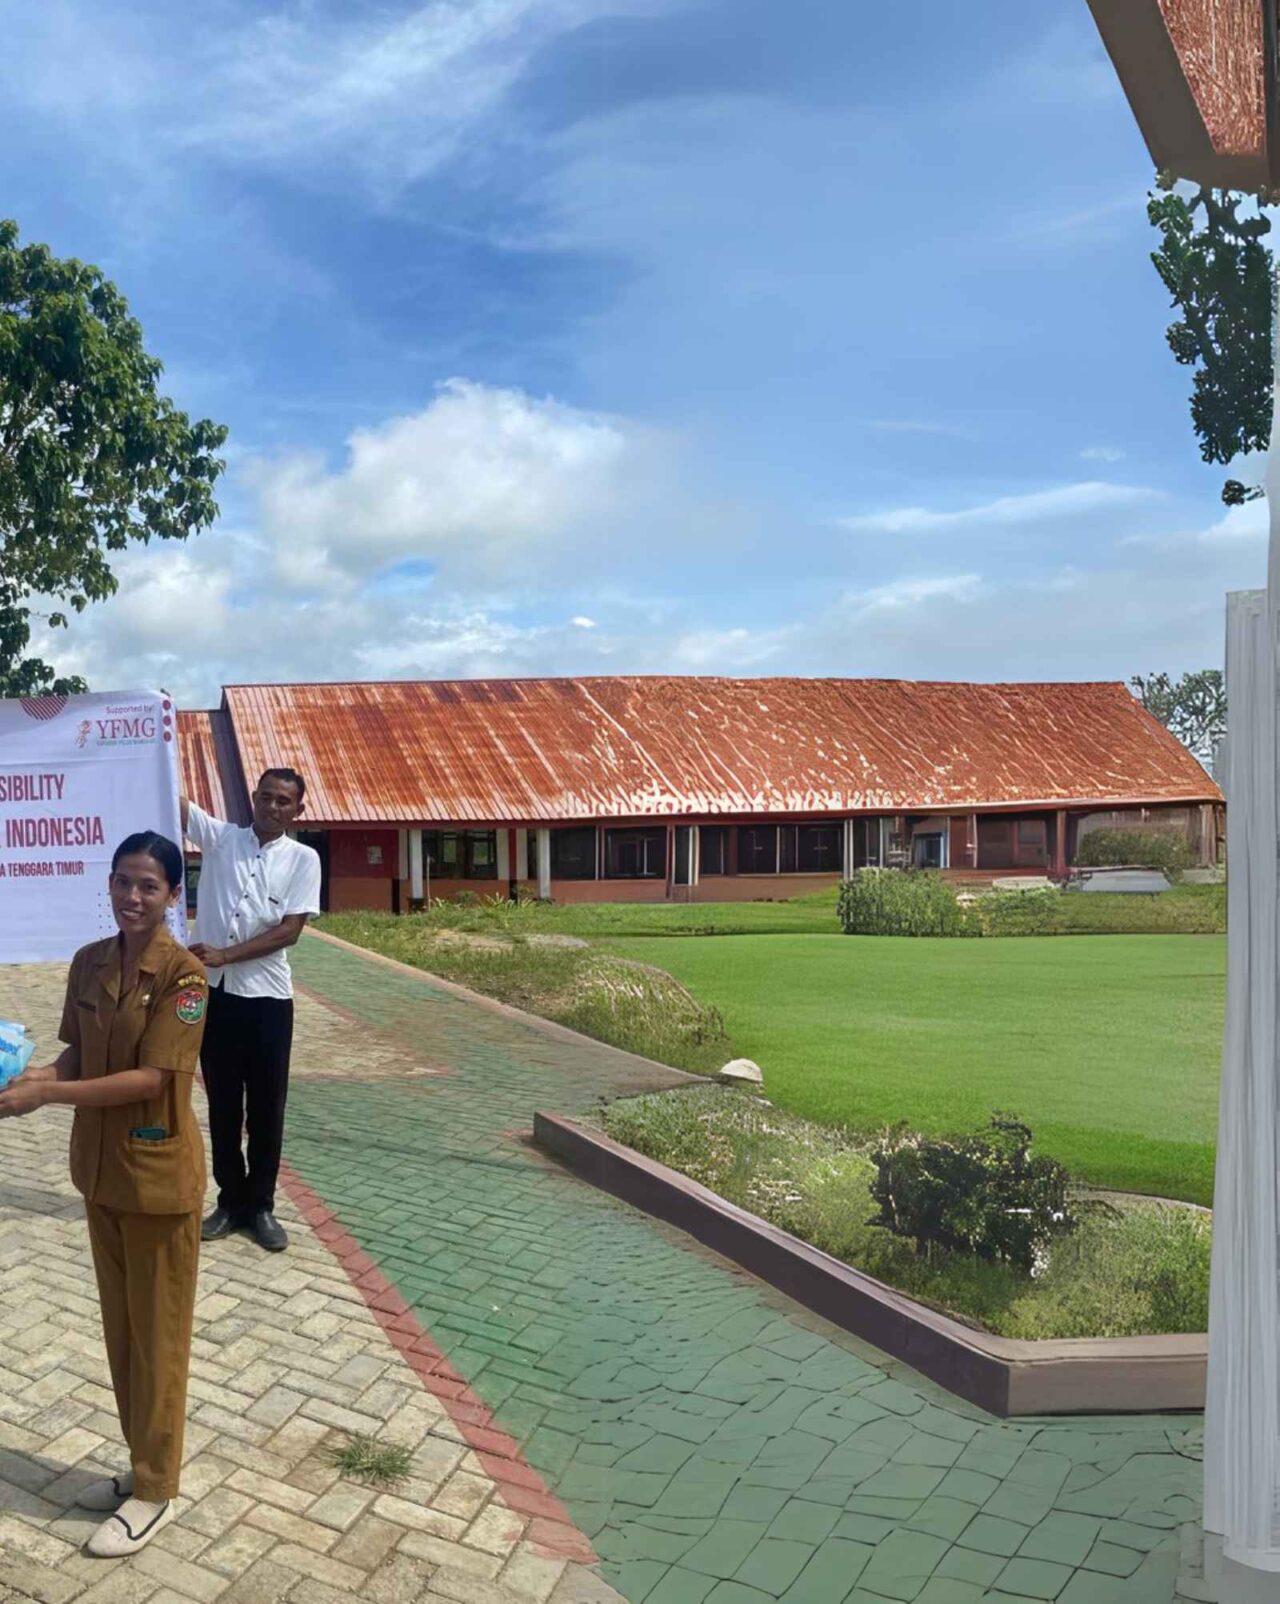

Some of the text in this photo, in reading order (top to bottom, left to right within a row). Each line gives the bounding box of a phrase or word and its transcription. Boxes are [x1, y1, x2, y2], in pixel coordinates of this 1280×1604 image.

[96, 717, 156, 739] YFMG
[6, 816, 105, 848] INDONESIA
[8, 862, 53, 878] TENGGARA
[55, 861, 85, 876] TIMUR
